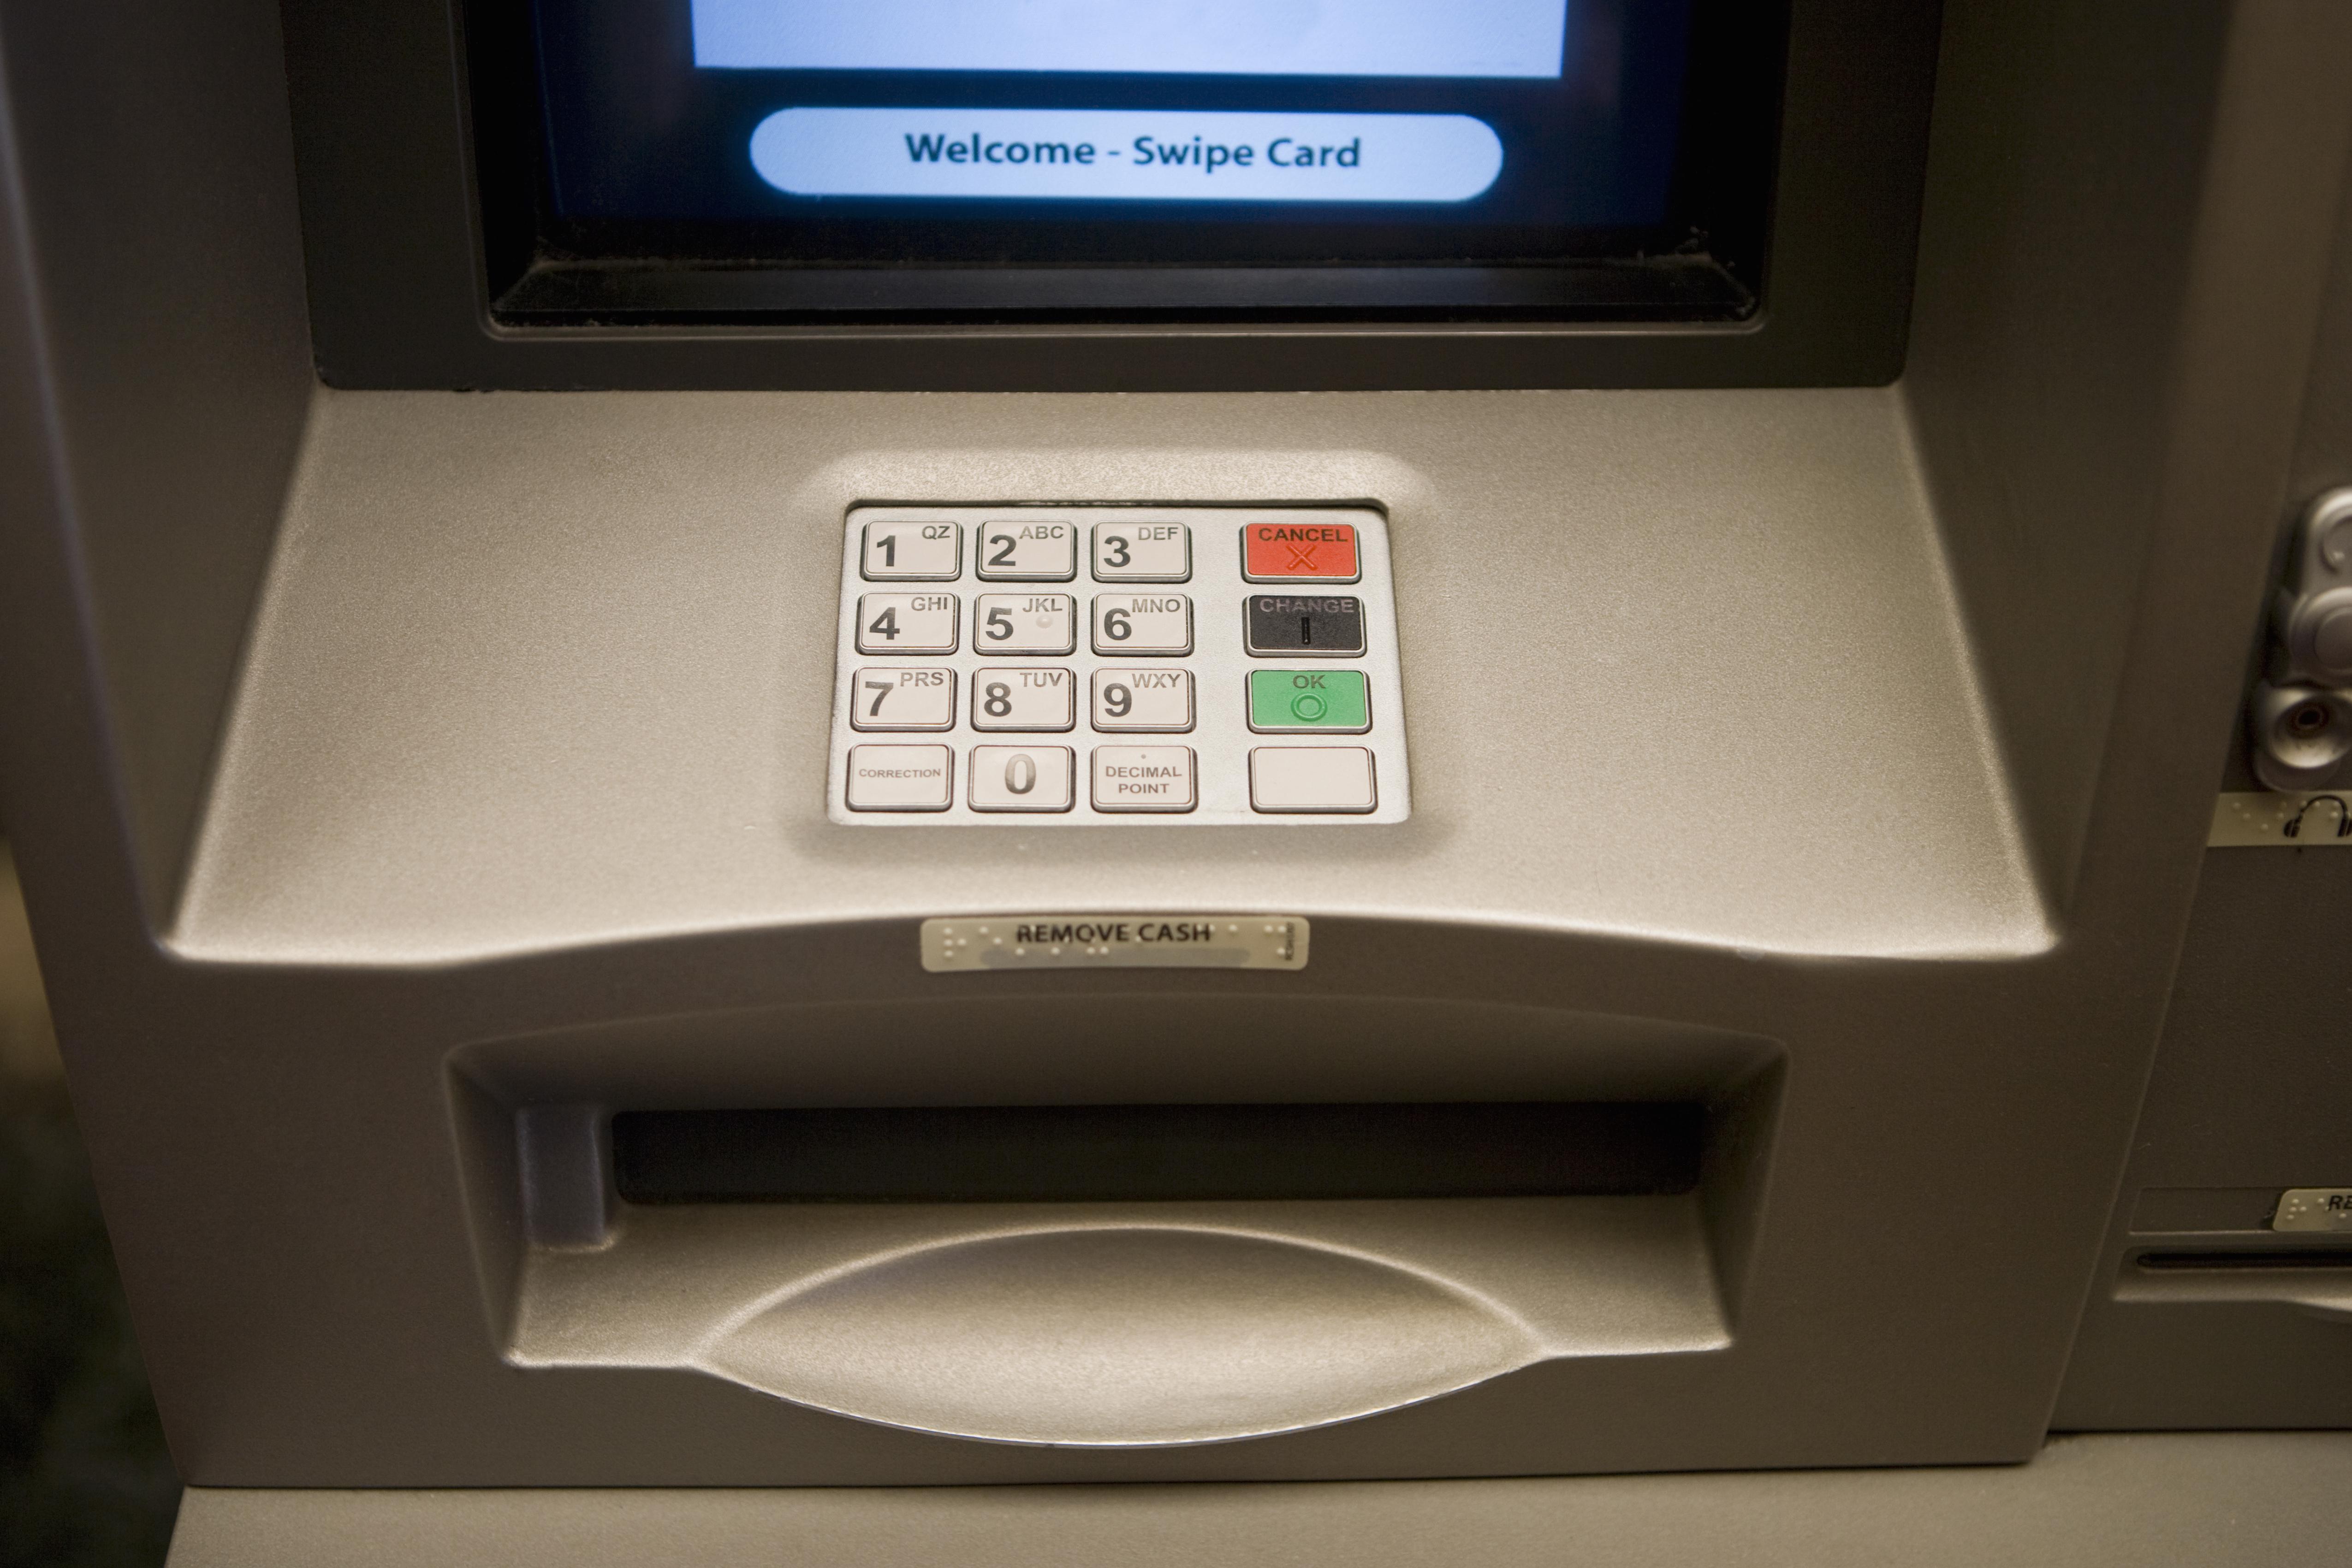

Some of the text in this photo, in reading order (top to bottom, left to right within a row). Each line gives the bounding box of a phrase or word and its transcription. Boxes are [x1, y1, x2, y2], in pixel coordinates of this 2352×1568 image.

[904, 132, 1096, 165] Welcome
[1133, 136, 1254, 174] Swipe
[1267, 137, 1361, 168] Card
[922, 526, 950, 540] QZ
[1018, 525, 1064, 540] ABC
[1138, 526, 1179, 541] DEF
[1258, 528, 1348, 542] CANCEL
[876, 535, 896, 567] 1
[988, 534, 1017, 567] 2
[1104, 535, 1132, 568] 3
[911, 597, 948, 612] GHI
[1022, 597, 1063, 613] JKL
[1131, 598, 1181, 613] MNO
[1259, 598, 1354, 614] CHANGE
[869, 607, 900, 640] 4
[985, 607, 1014, 641] 5
[1104, 607, 1132, 641] 6
[900, 672, 944, 687] PRS
[1020, 672, 1063, 687] TUV
[1131, 673, 1182, 688] WXY
[1293, 675, 1326, 689] OK
[864, 681, 894, 717] 7
[983, 682, 1012, 717] 8
[1104, 683, 1132, 718] 9
[858, 768, 941, 778] CORRECTION
[1004, 753, 1037, 795] 0
[1105, 765, 1182, 778] DECIMAL
[1118, 783, 1170, 794] POINT
[1016, 923, 1212, 943] REMOVE CASH
